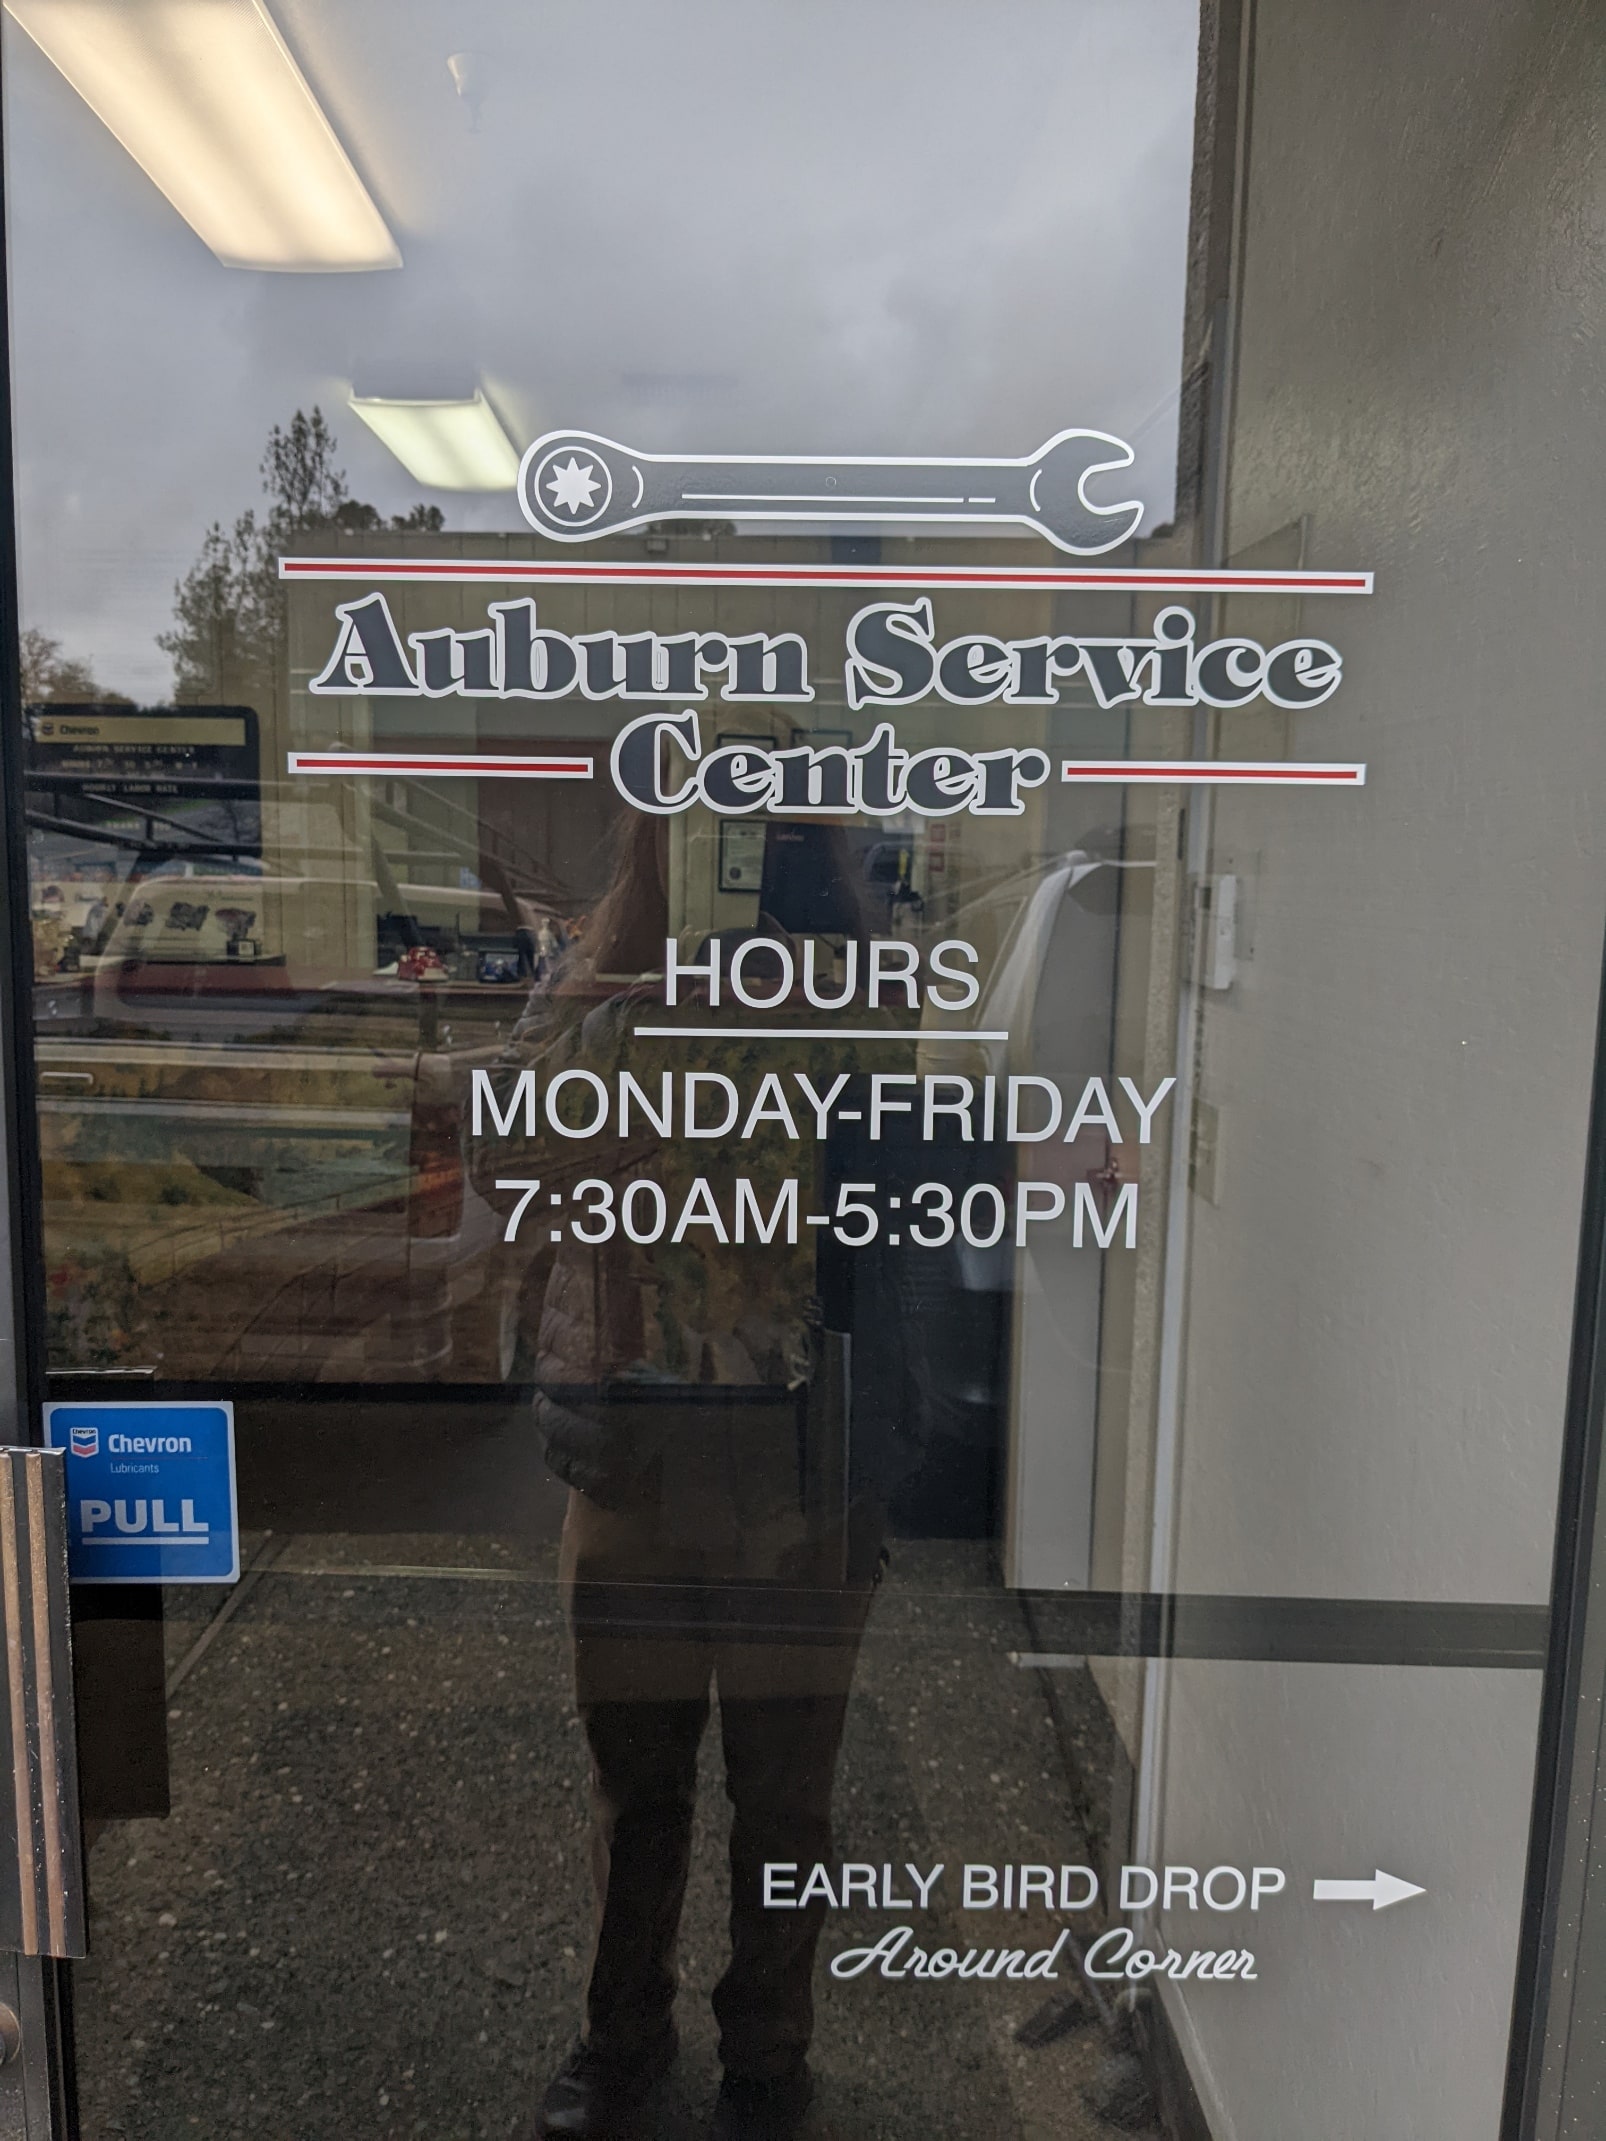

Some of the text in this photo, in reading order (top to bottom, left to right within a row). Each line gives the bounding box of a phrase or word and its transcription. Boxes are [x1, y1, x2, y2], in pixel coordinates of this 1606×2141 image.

[308, 592, 1344, 710] Auburn Service
[610, 708, 1051, 816] Center
[664, 937, 981, 1011] HOURS
[471, 1068, 1178, 1144] MONDAY-FRIDAY
[494, 1178, 1139, 1249] 7:30AM-5:30PM
[108, 1434, 192, 1453] Chevron
[110, 1463, 160, 1474] Lubricants
[80, 1499, 209, 1533] PULL
[762, 1862, 1286, 1911] EARLY BIRD DROP
[830, 1926, 1258, 1980] Around Corner
